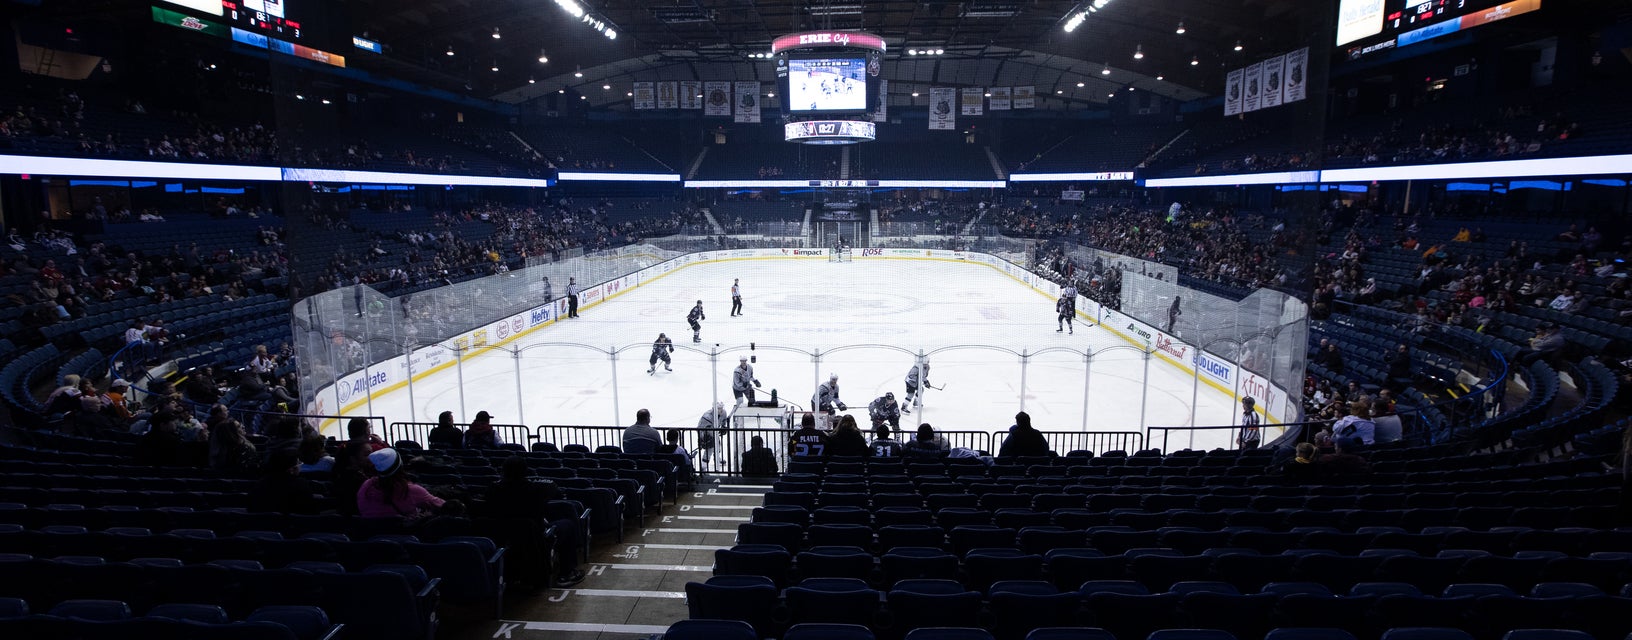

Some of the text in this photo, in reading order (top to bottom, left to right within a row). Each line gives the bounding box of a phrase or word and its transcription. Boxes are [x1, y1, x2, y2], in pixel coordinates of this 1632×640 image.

[799, 33, 832, 44] ERIE
[862, 248, 882, 257] ROSE
[531, 309, 550, 325] Hefty
[1207, 359, 1230, 380] LIGHT
[875, 445, 891, 457] 31
[642, 529, 656, 537] F
[625, 545, 640, 554] G
[587, 565, 606, 576] H
[548, 590, 570, 603] J
[493, 622, 521, 639] K
